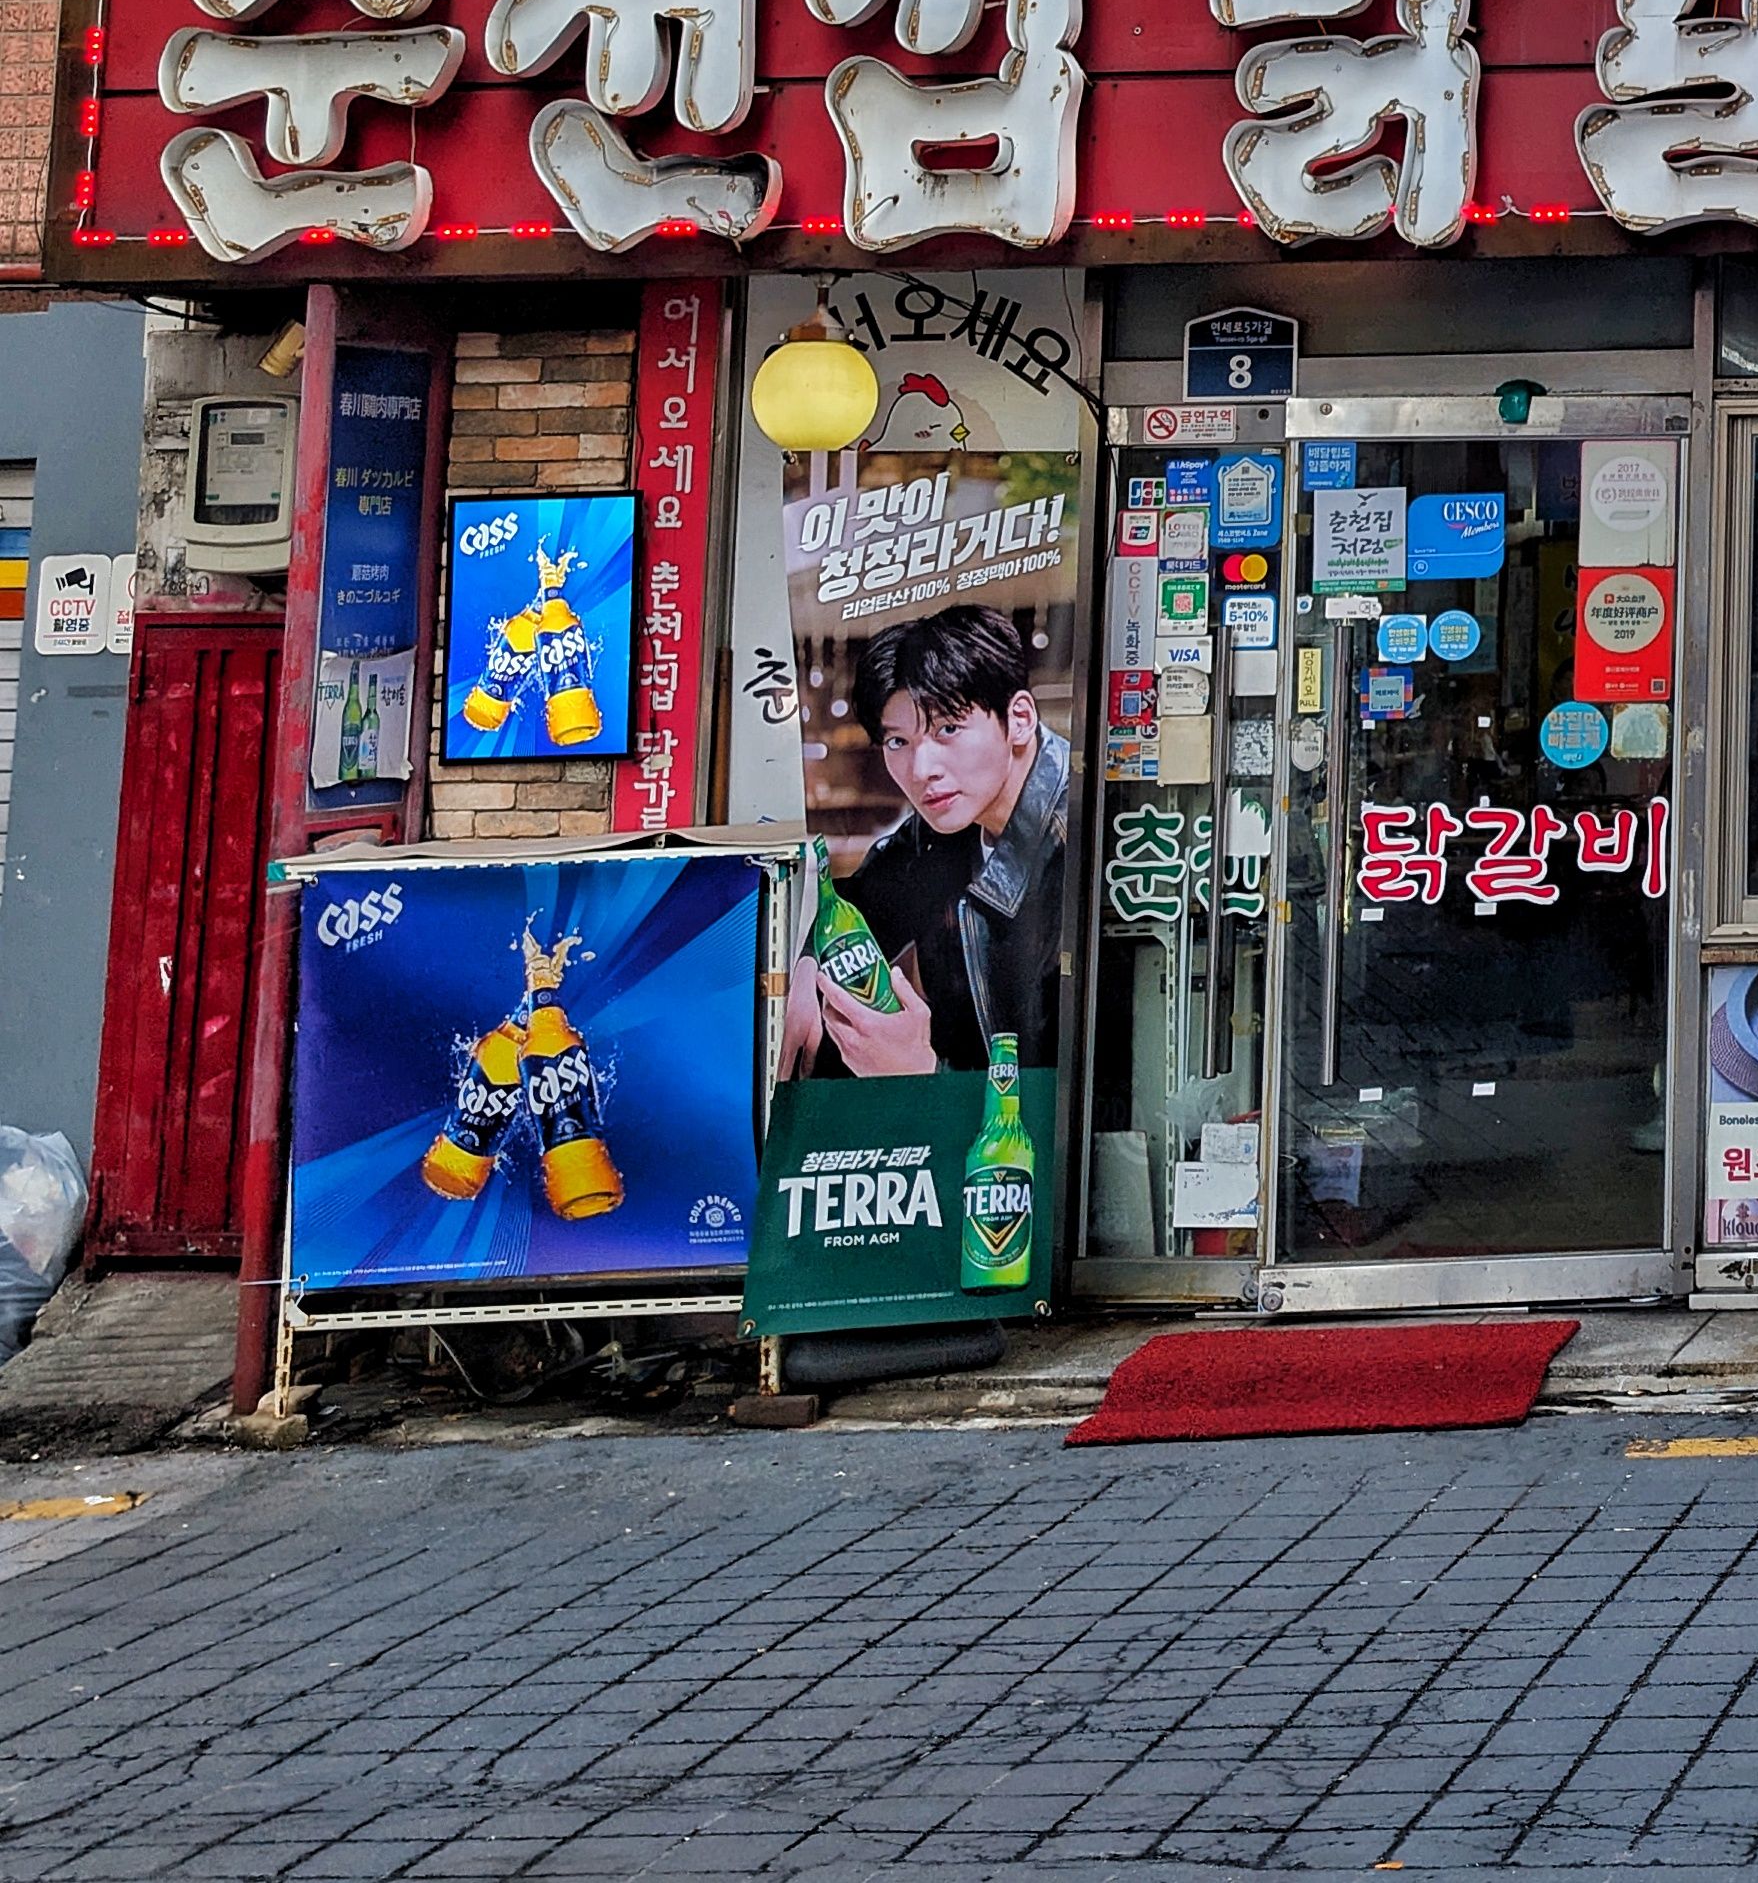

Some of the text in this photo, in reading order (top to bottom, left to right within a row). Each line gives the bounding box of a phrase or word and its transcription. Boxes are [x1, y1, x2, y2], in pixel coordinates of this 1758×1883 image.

[1211, 321, 1273, 335] 연세로5가길
[1228, 354, 1252, 389] 8
[1180, 410, 1232, 423] 금연구역
[640, 294, 701, 713] 어서오세요 춘천집
[1443, 500, 1499, 521] CESCO
[1329, 509, 1394, 534] 춘천집
[1460, 521, 1501, 540] Members
[816, 492, 1067, 606] 청정라거다!
[840, 547, 1062, 622] 리얼탄산100% 청정맥아100%
[1225, 582, 1267, 591] mastercard
[49, 599, 97, 616] CCTV
[1126, 561, 1142, 666] CCTV 녹화중
[1229, 610, 1269, 623] 5-10%
[53, 617, 91, 633] 촬영중
[1613, 629, 1636, 640] 2019
[1169, 648, 1201, 663] VISA
[318, 681, 345, 702] TERRA
[1357, 796, 1670, 904] 닭갈비
[345, 929, 384, 954] FRESH
[820, 932, 883, 983] TERRA
[800, 1144, 933, 1174] 청정라거-테라
[777, 1169, 944, 1240] TERRA
[962, 1184, 1033, 1220] TERRA
[823, 1229, 901, 1250] FROM AGM
